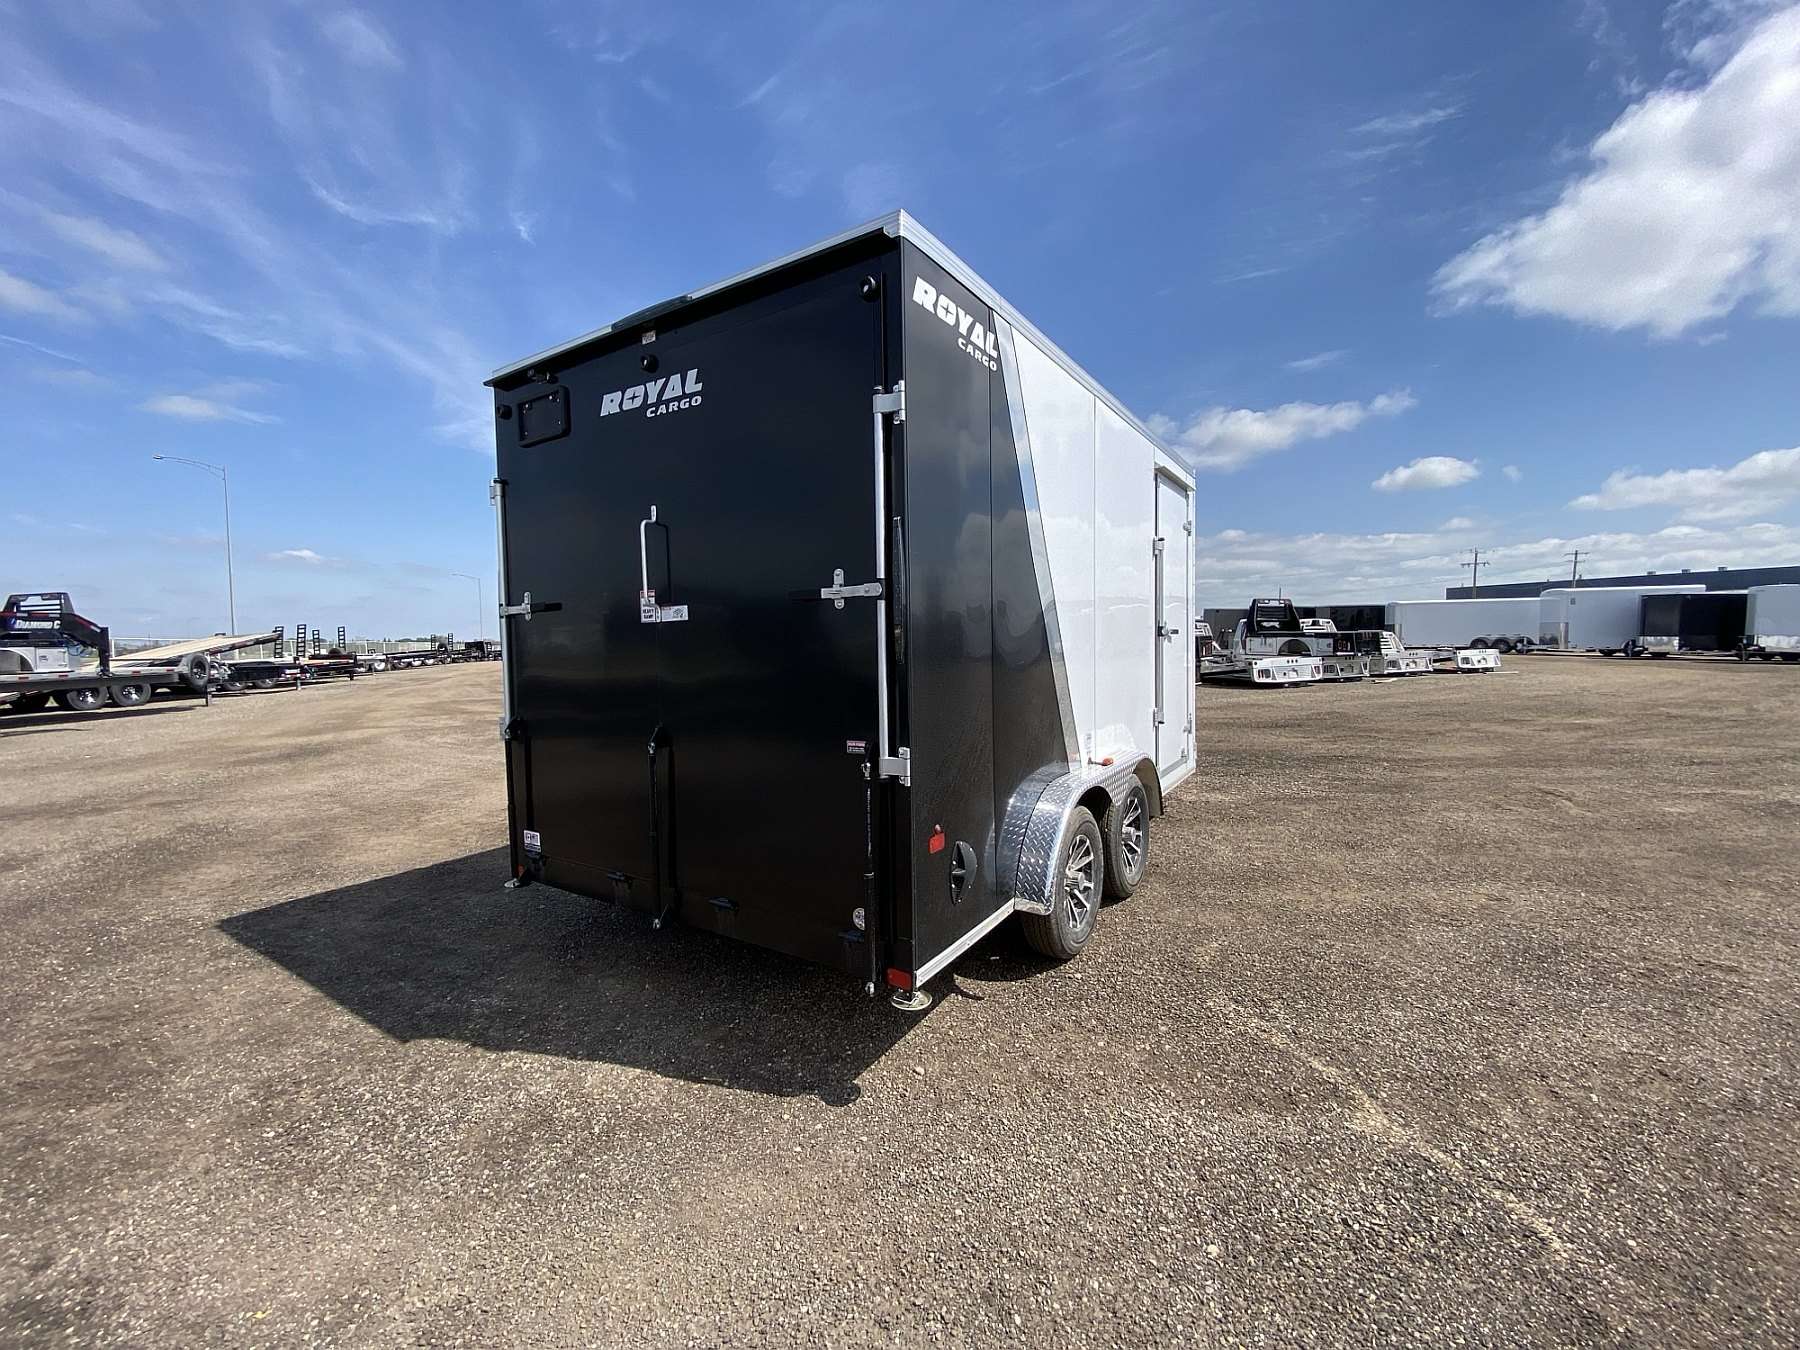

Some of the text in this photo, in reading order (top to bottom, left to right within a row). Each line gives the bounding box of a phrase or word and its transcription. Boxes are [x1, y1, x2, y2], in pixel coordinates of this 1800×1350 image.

[912, 276, 998, 358] ROYAL
[957, 338, 997, 371] CARGO
[600, 368, 703, 417] ROYAL
[646, 396, 702, 418] CARGO
[16, 620, 61, 629] DIAMOND C
